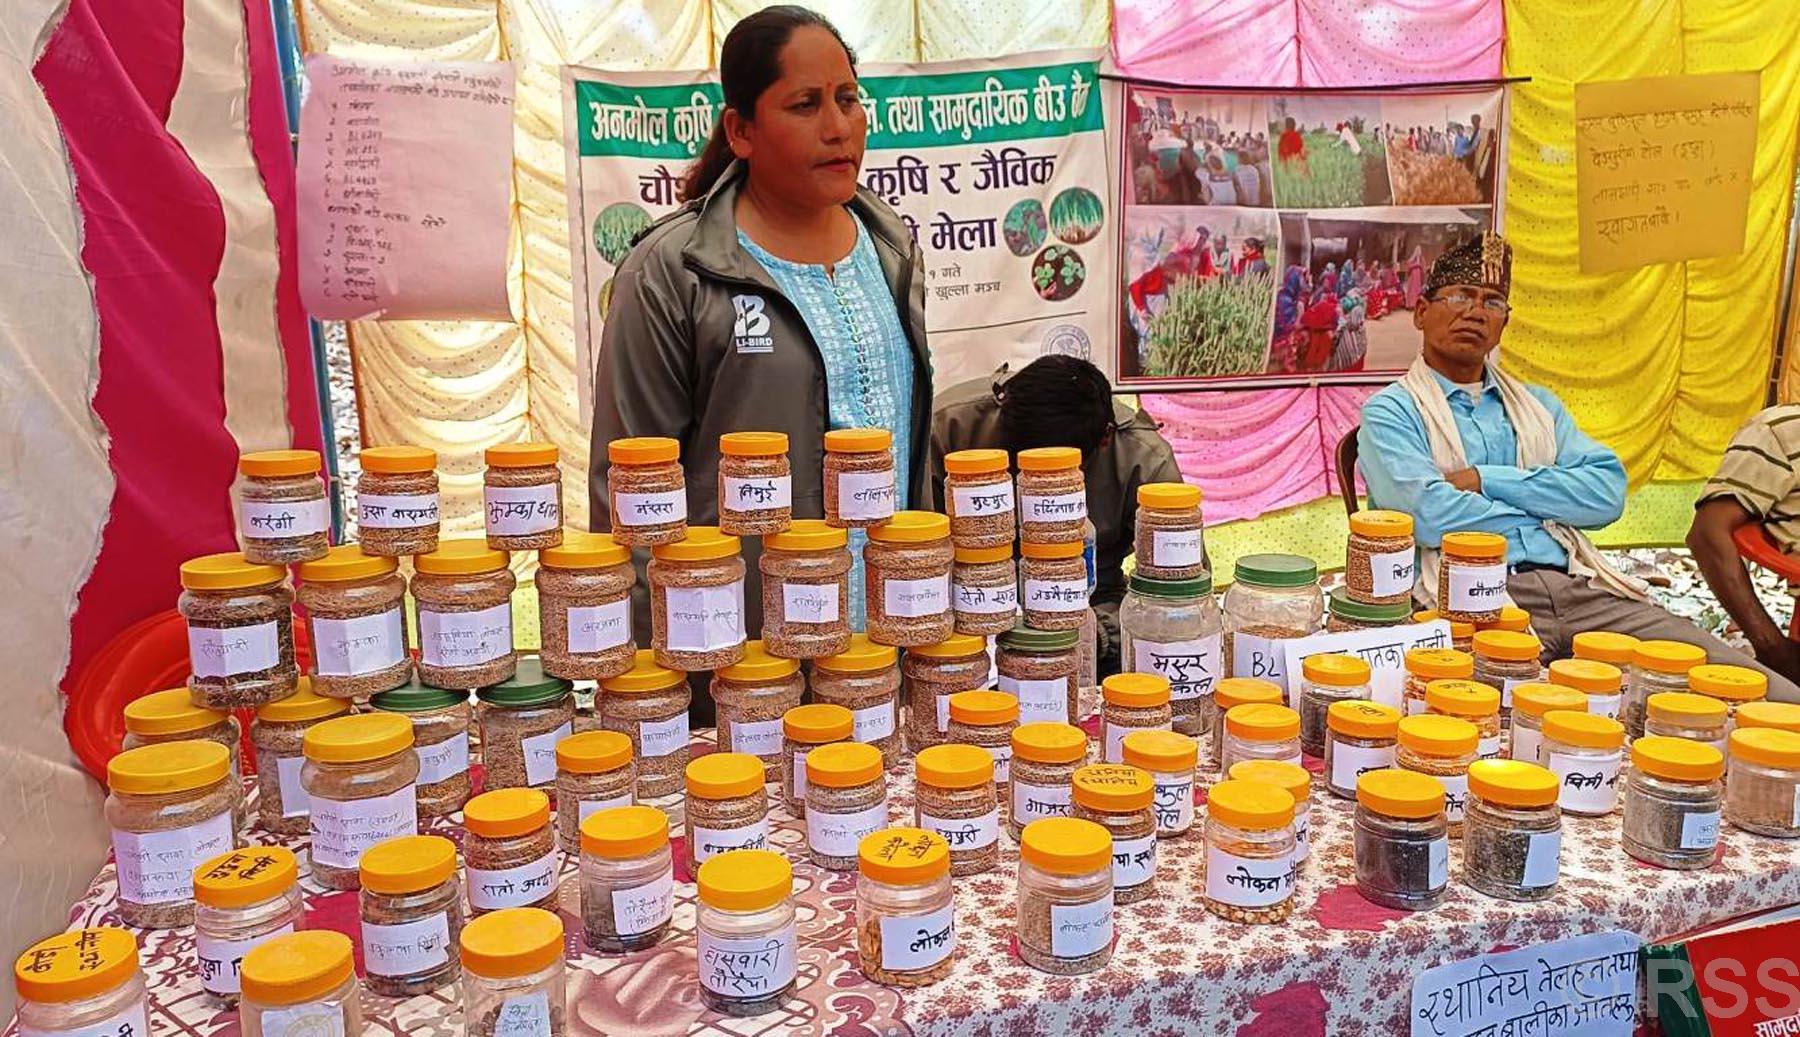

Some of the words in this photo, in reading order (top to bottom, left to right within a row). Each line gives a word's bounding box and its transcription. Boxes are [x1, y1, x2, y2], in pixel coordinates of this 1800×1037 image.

[589, 95, 669, 147] अनमोल
[886, 95, 924, 135] तथा
[928, 76, 1029, 140] सामुदायिक
[1033, 74, 1067, 122] बीउ
[866, 155, 929, 206] कृषि
[939, 163, 961, 194] र
[971, 147, 1058, 190] जैविक
[930, 212, 998, 251] मेला
